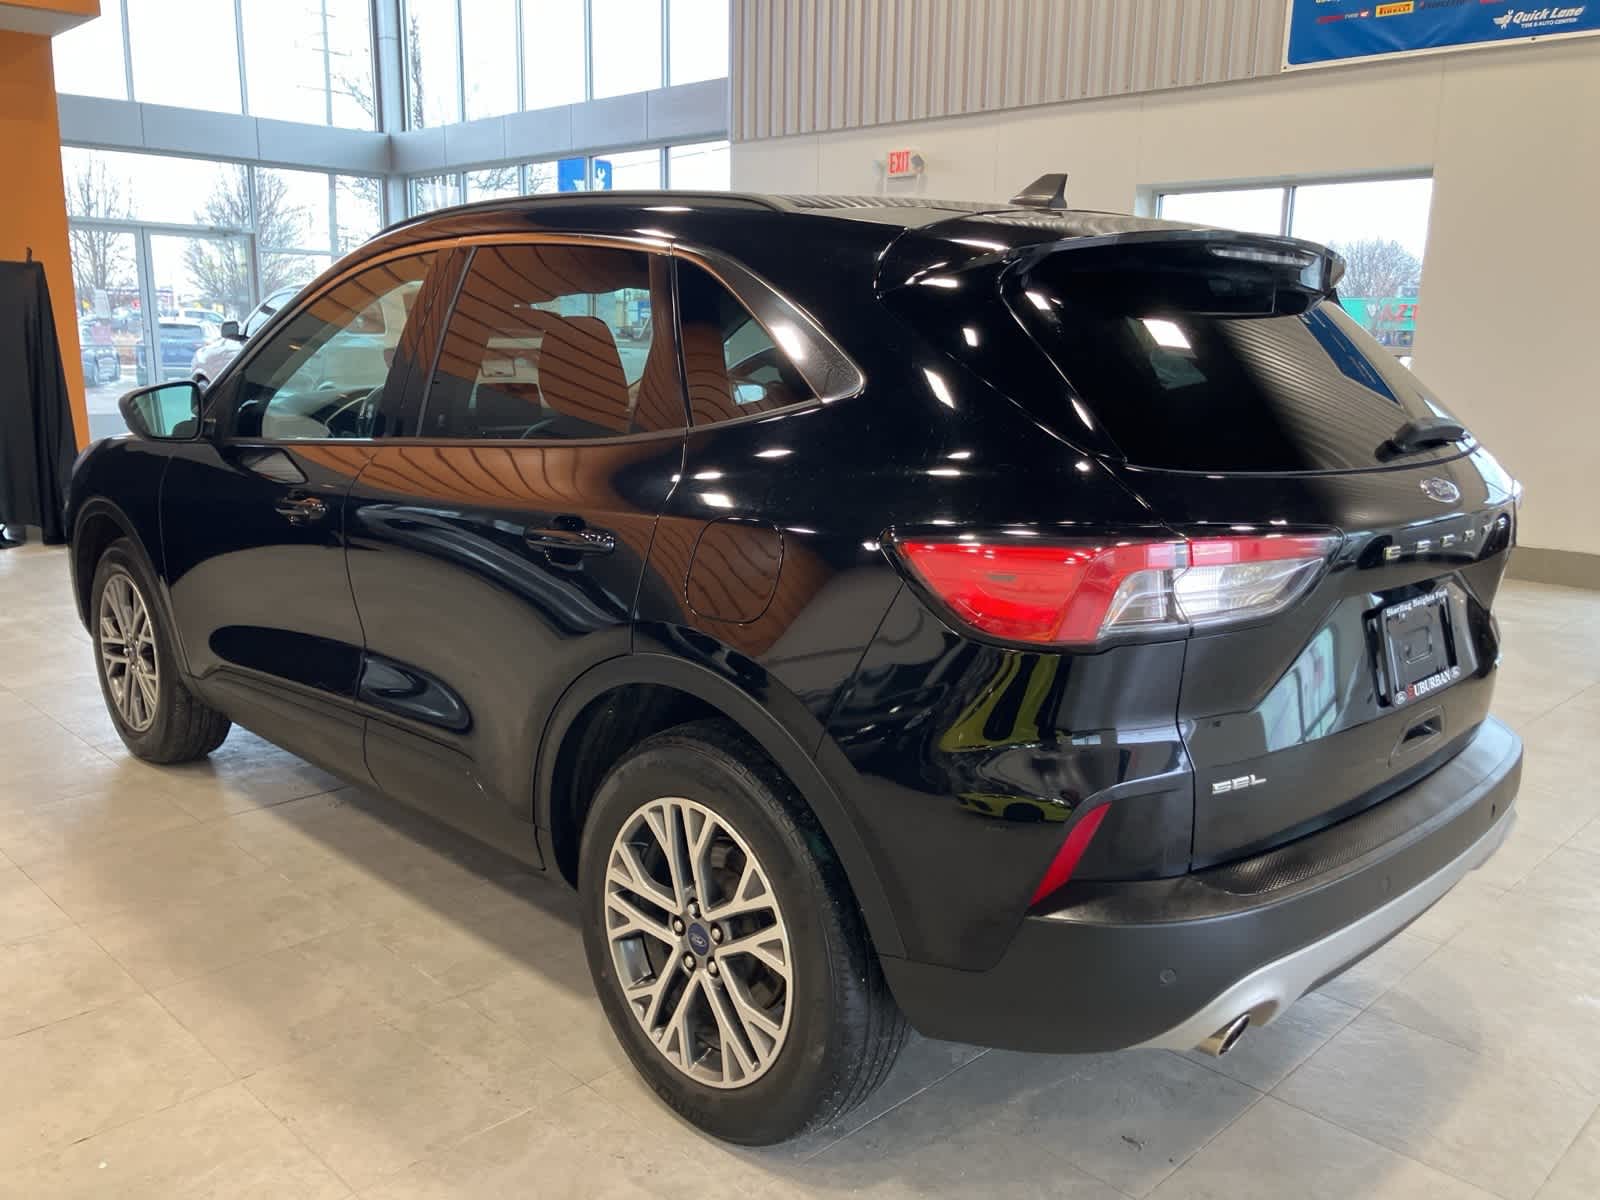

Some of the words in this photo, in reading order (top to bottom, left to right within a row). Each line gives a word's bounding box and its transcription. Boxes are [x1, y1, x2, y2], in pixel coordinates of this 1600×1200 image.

[1513, 8, 1549, 24] Quick
[1549, 6, 1585, 19] Lane
[889, 151, 910, 174] EXIT
[1408, 670, 1451, 698] SUBURBAN
[1212, 774, 1267, 795] SEL
